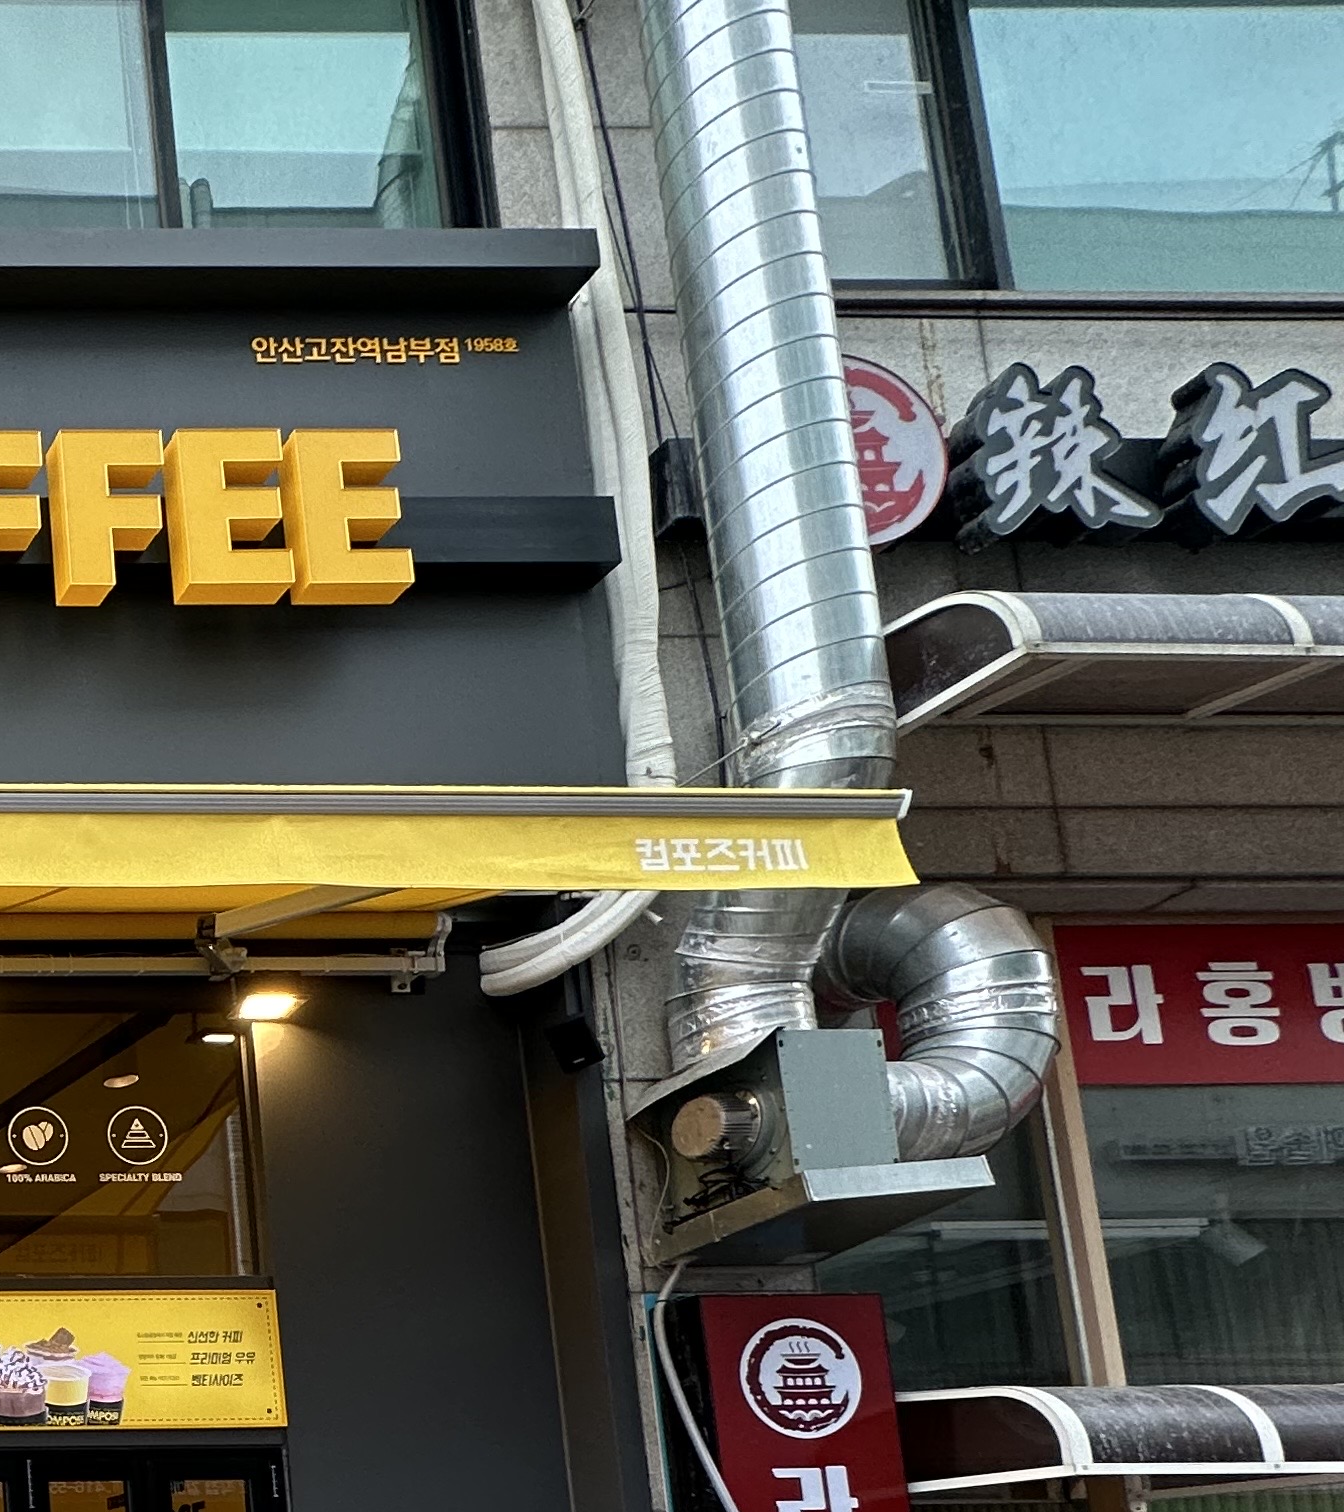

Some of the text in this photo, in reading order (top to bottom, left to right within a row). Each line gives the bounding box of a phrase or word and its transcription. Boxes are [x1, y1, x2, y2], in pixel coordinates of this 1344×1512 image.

[251, 337, 520, 365] 안산고잔역남부점 1958호
[634, 836, 804, 870] 컴포즈커피
[99, 1172, 149, 1182] SPECIALTY
[222, 1330, 243, 1343] 커피
[189, 1352, 232, 1365] 프리미엄
[235, 1351, 256, 1364] 우유
